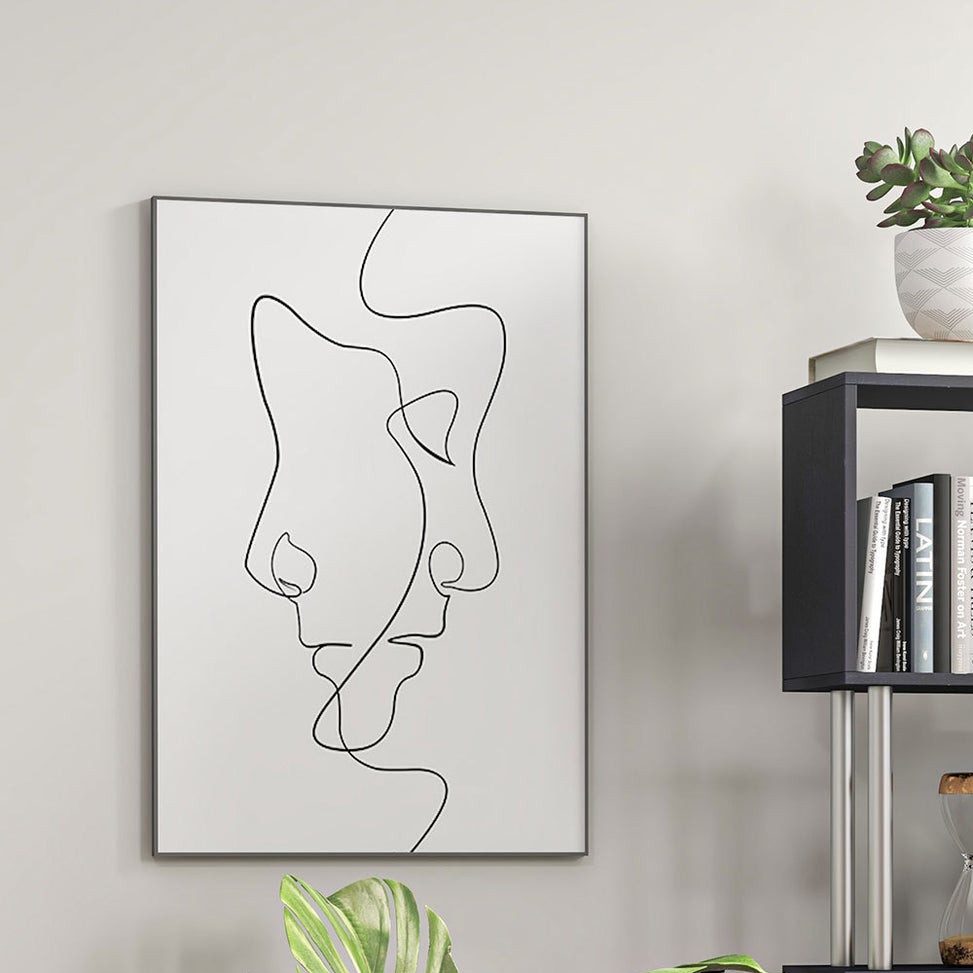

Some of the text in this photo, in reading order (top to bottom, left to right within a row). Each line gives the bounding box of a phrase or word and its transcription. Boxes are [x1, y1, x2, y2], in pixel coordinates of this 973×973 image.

[916, 518, 933, 603] LATIN
[956, 478, 967, 638] Moving Norman Foster on Art
